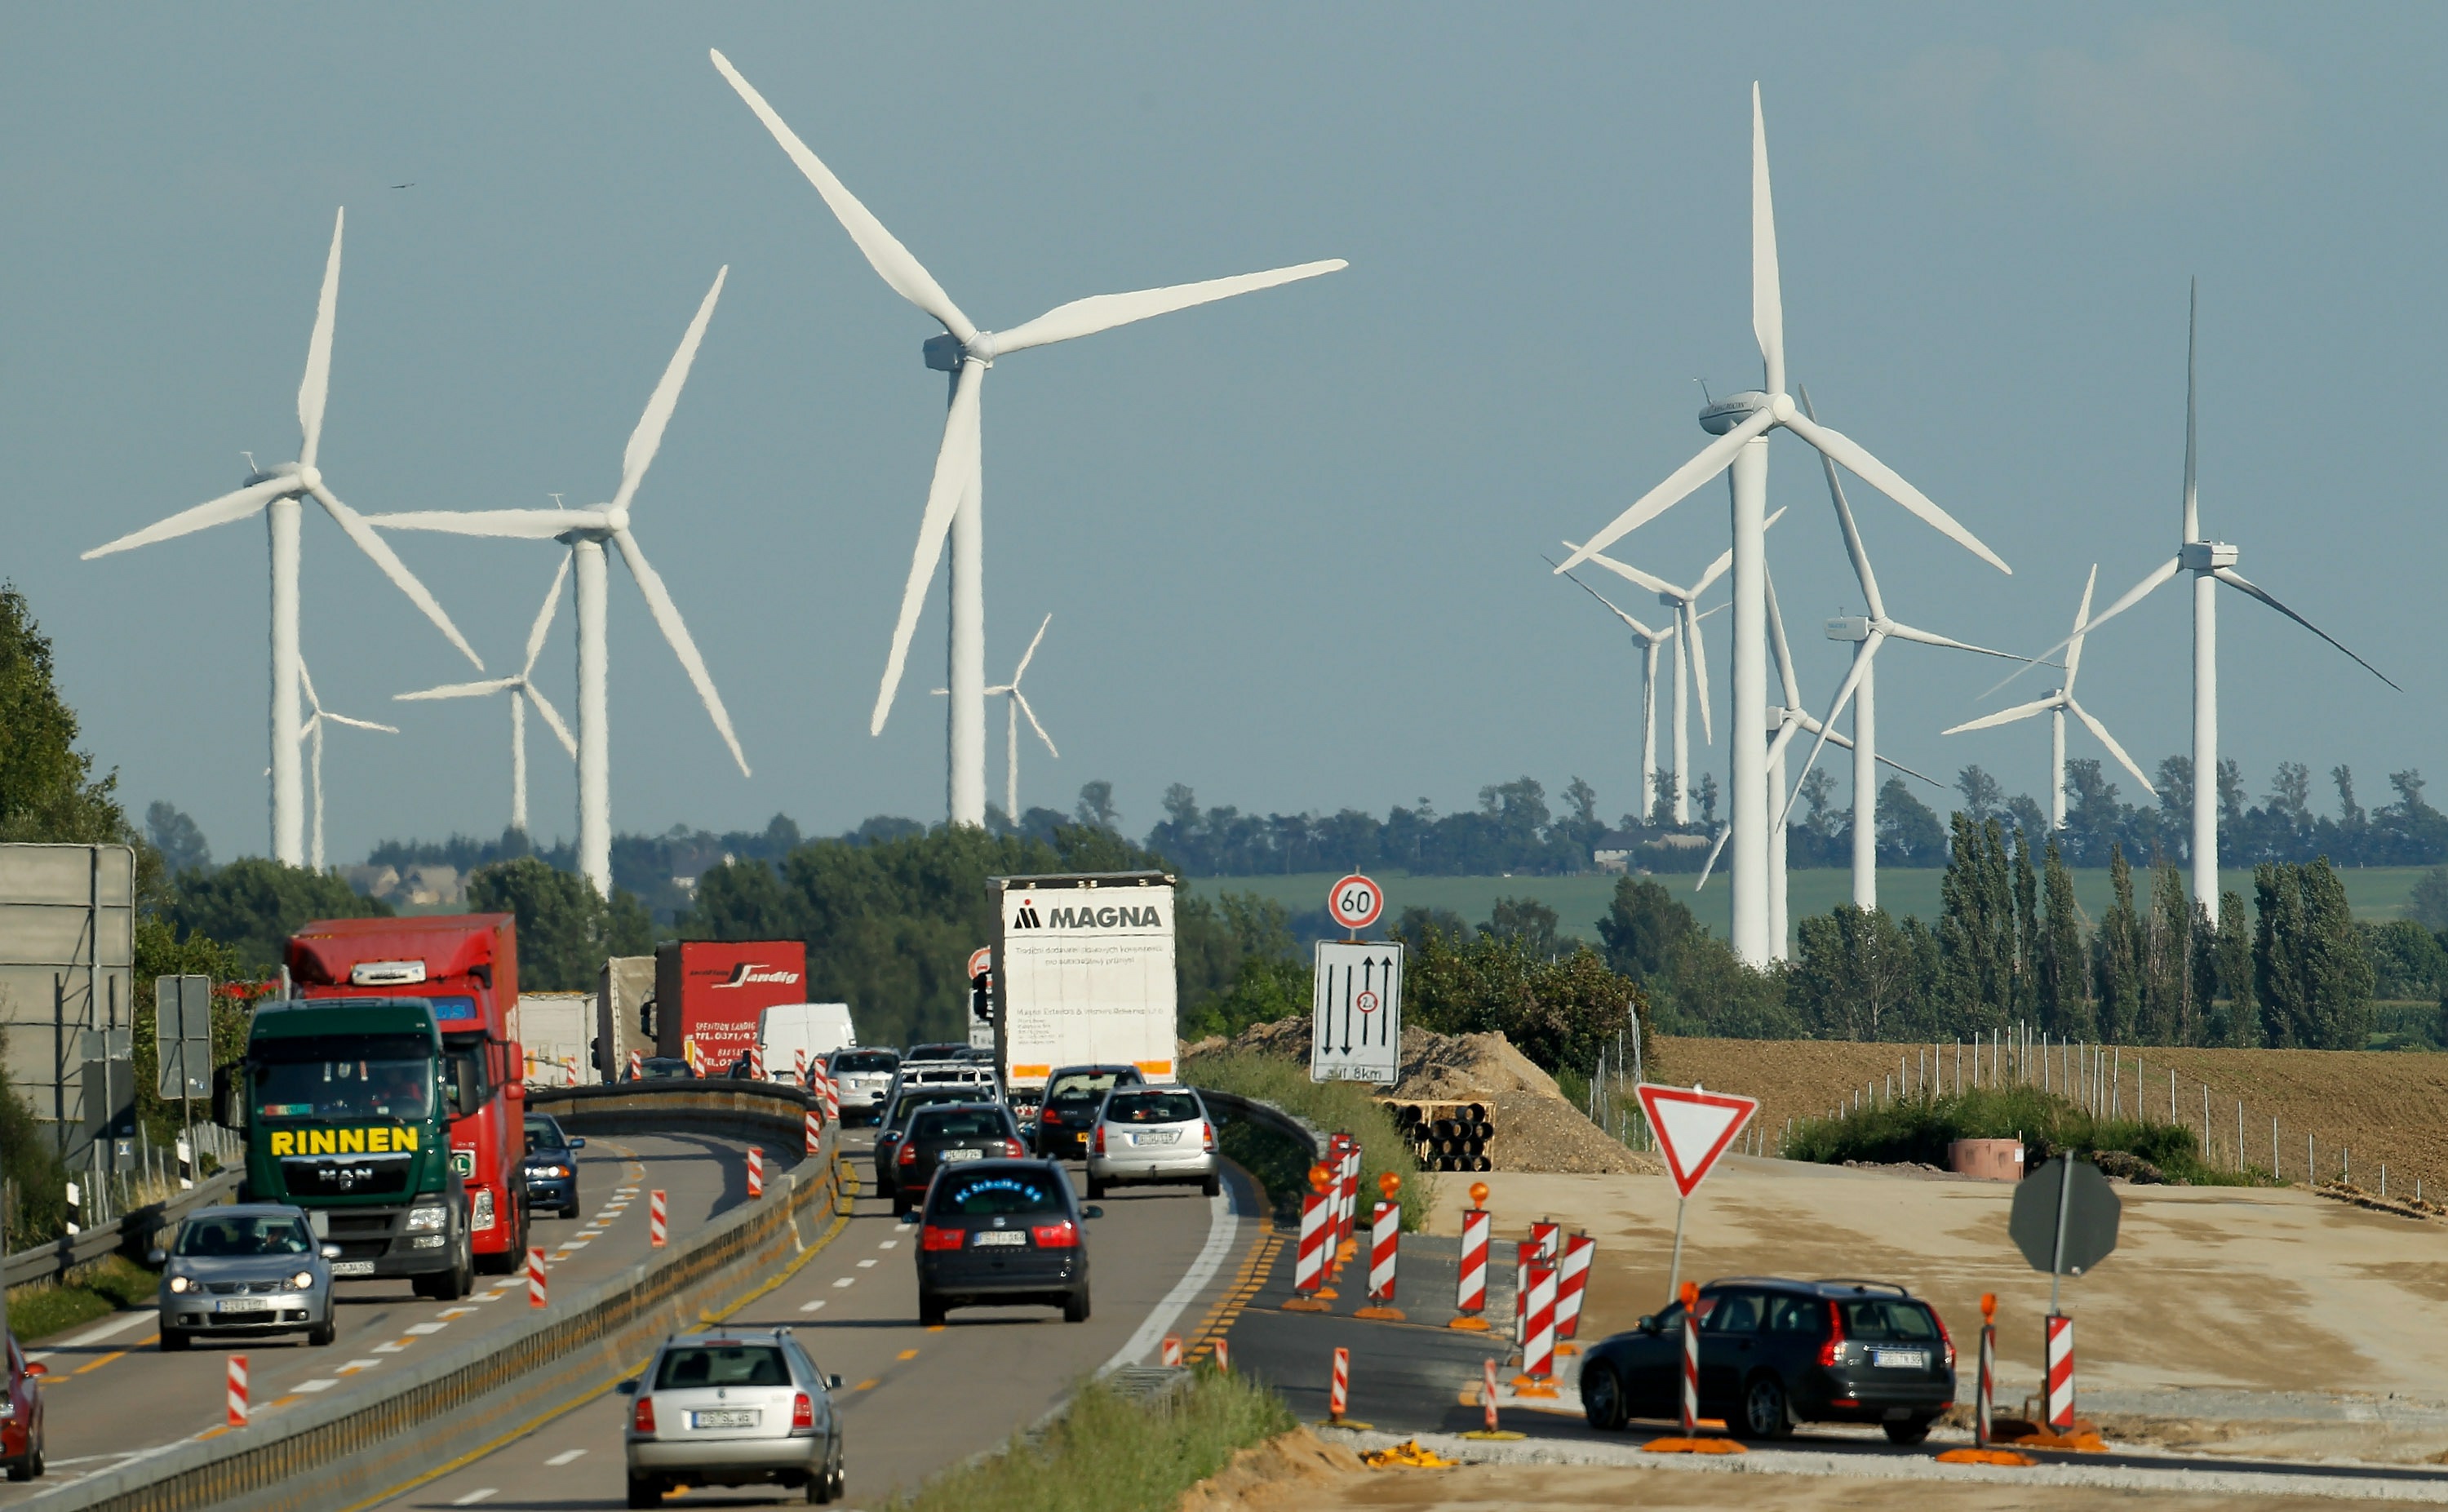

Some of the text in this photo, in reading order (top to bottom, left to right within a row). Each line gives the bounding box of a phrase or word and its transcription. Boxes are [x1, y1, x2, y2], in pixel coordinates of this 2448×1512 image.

[1341, 889, 1371, 913] 60
[1049, 906, 1162, 929] MAGNA
[270, 1126, 419, 1156] RINNEN
[318, 1168, 373, 1182] MAN
